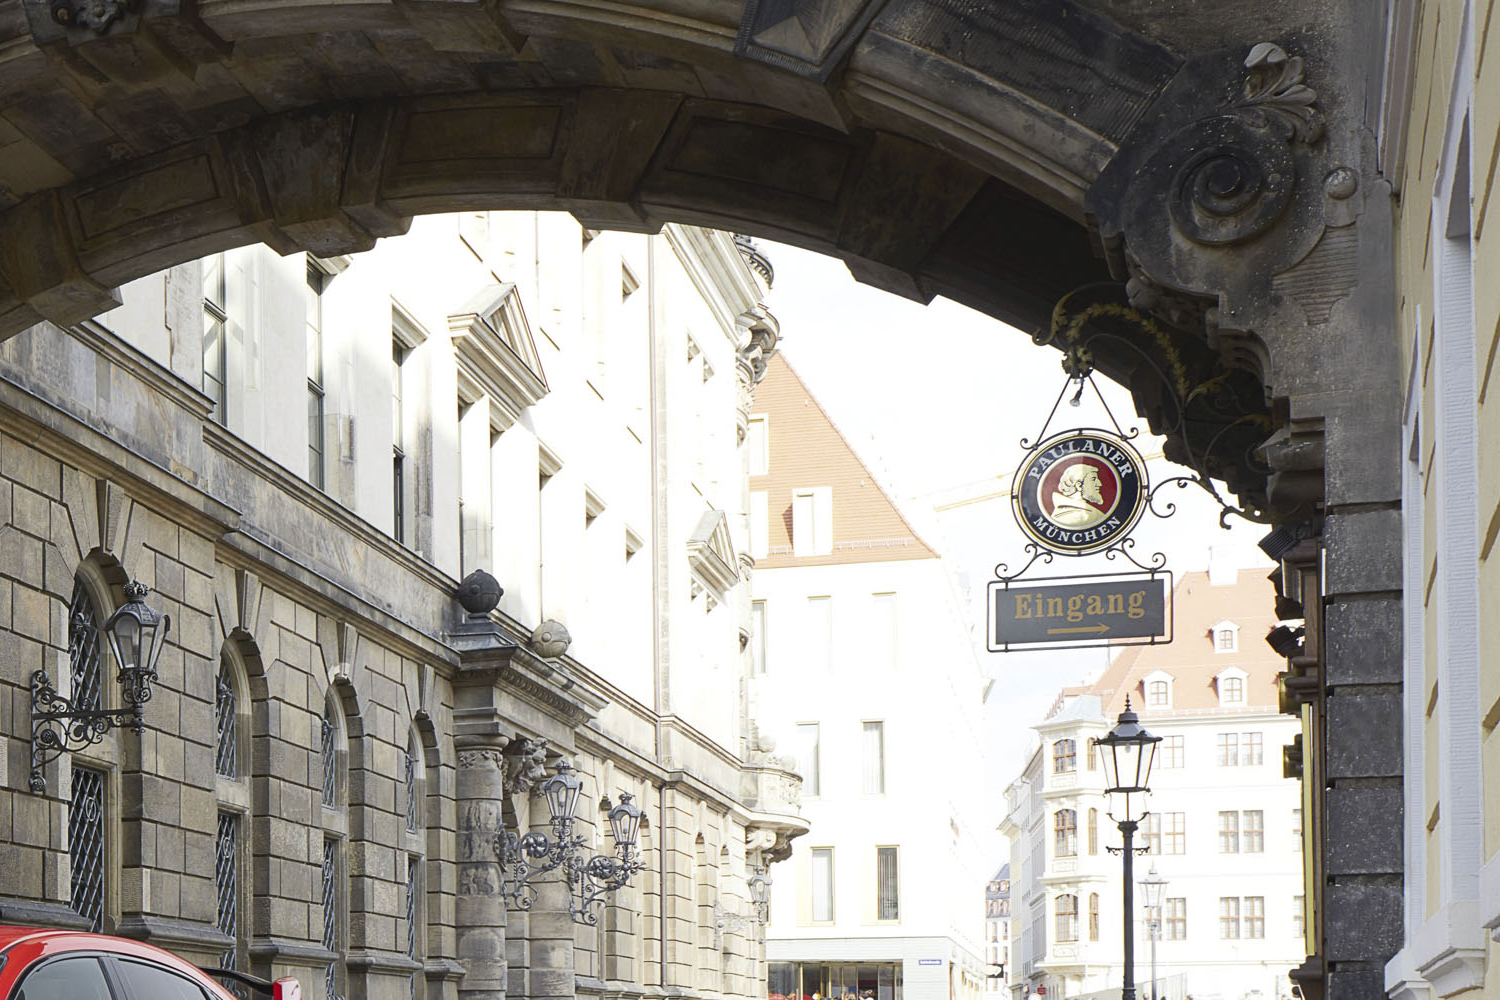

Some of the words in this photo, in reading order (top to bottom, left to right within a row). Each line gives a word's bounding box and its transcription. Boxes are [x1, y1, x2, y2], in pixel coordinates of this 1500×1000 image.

[1028, 440, 1133, 480] PAULANER
[1033, 516, 1121, 543] MÜNCHEN
[1014, 590, 1146, 622] Eingang
